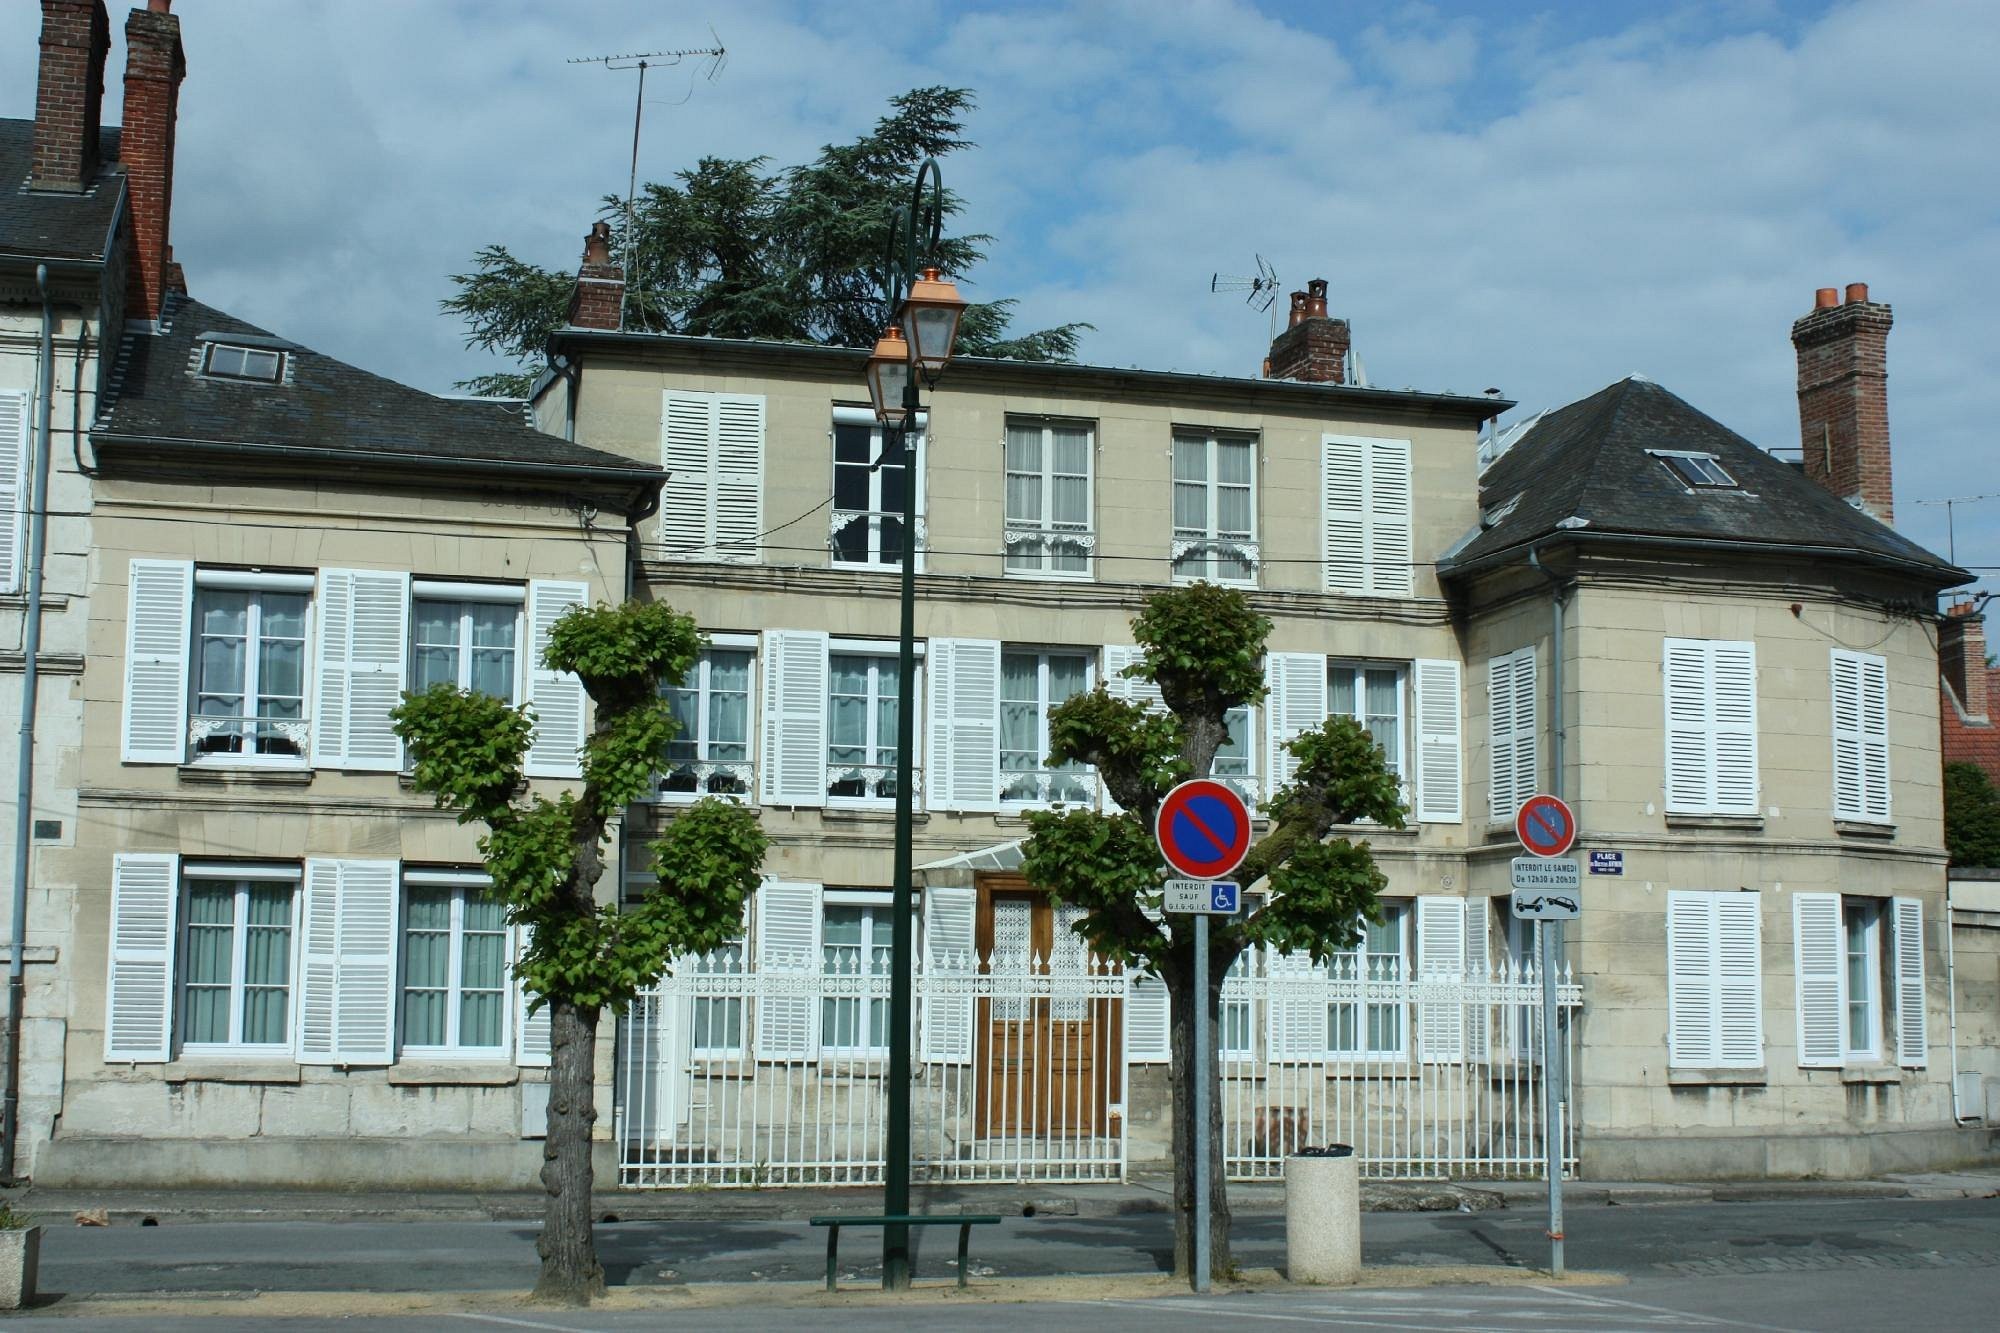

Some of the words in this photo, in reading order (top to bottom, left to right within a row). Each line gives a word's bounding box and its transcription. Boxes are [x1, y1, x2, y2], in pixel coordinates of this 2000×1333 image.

[1515, 863, 1542, 872] INTERDIT
[1544, 864, 1551, 872] LE
[1553, 864, 1577, 873] SAMEDI
[1528, 875, 1547, 883] 12h30
[1556, 875, 1577, 884] 20h30
